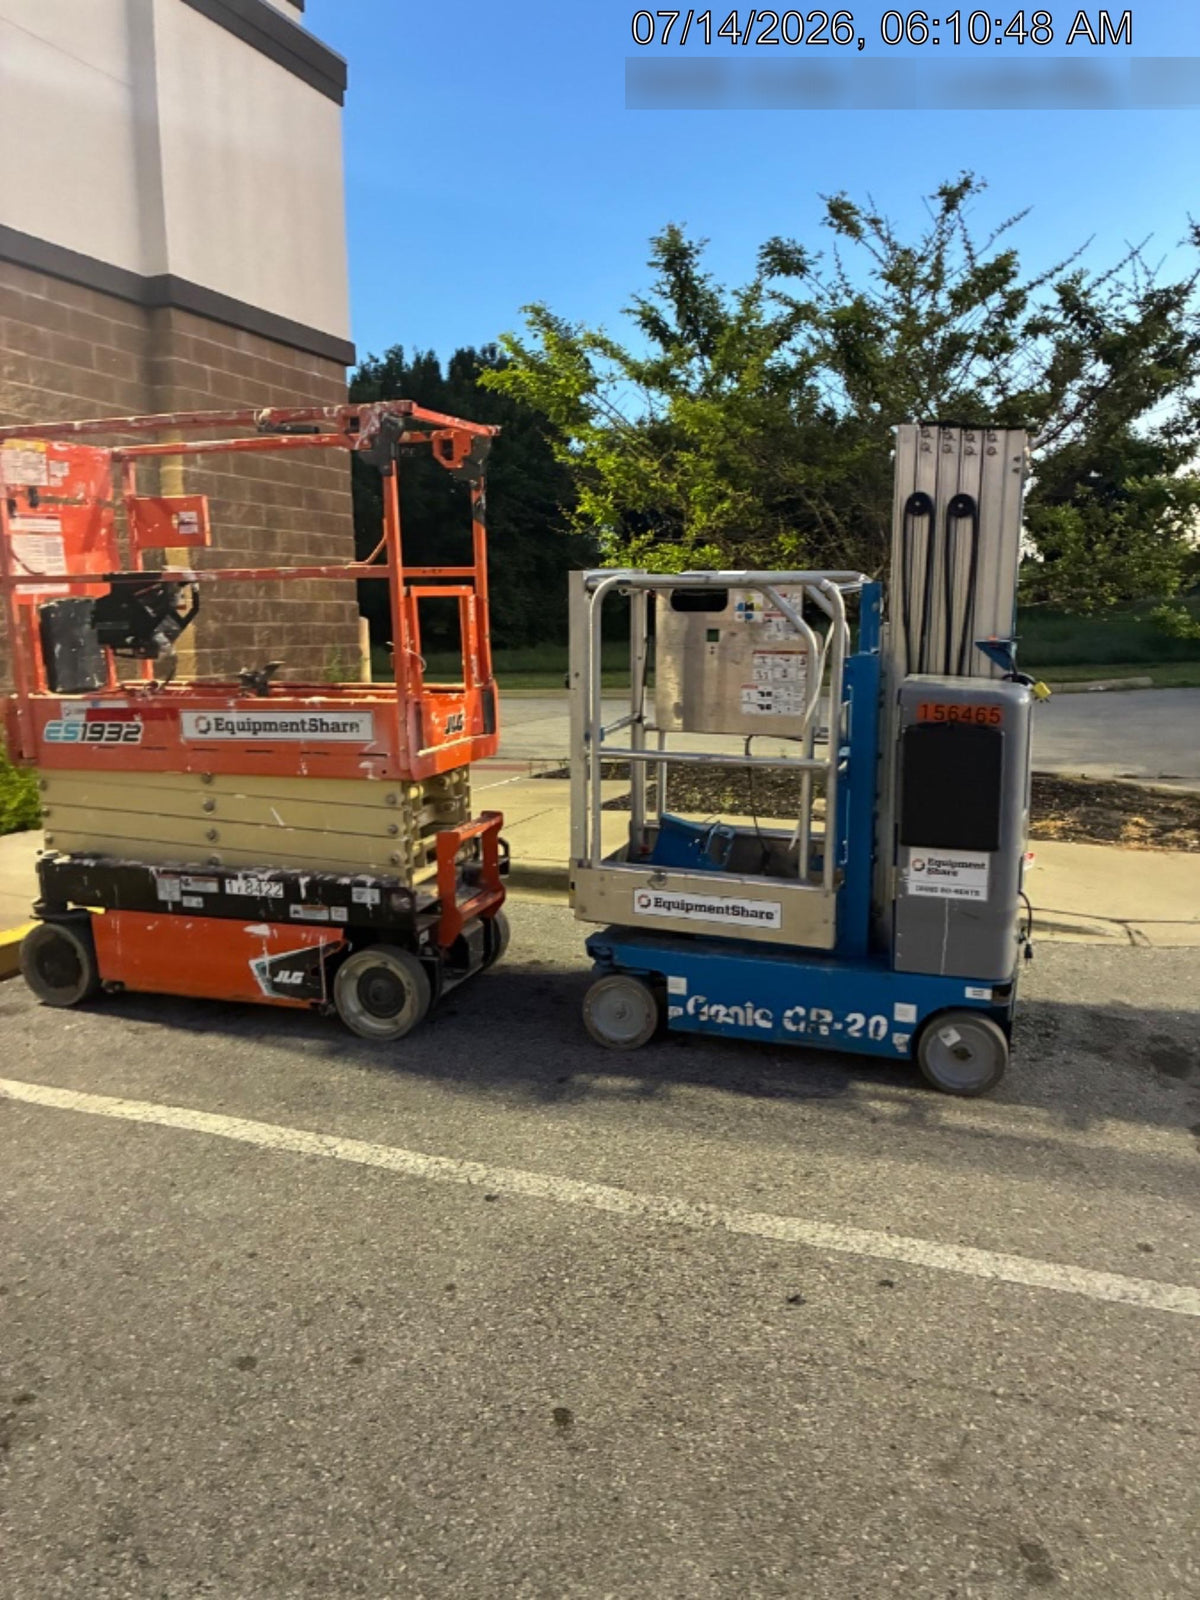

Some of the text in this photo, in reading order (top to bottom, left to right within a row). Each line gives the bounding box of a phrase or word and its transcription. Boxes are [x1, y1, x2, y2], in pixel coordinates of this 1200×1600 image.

[921, 704, 1001, 724] 156465
[44, 722, 141, 742] ES1932
[214, 717, 361, 735] EquipmentShare
[653, 897, 775, 920] EquipmentShare
[273, 970, 305, 984] JLG
